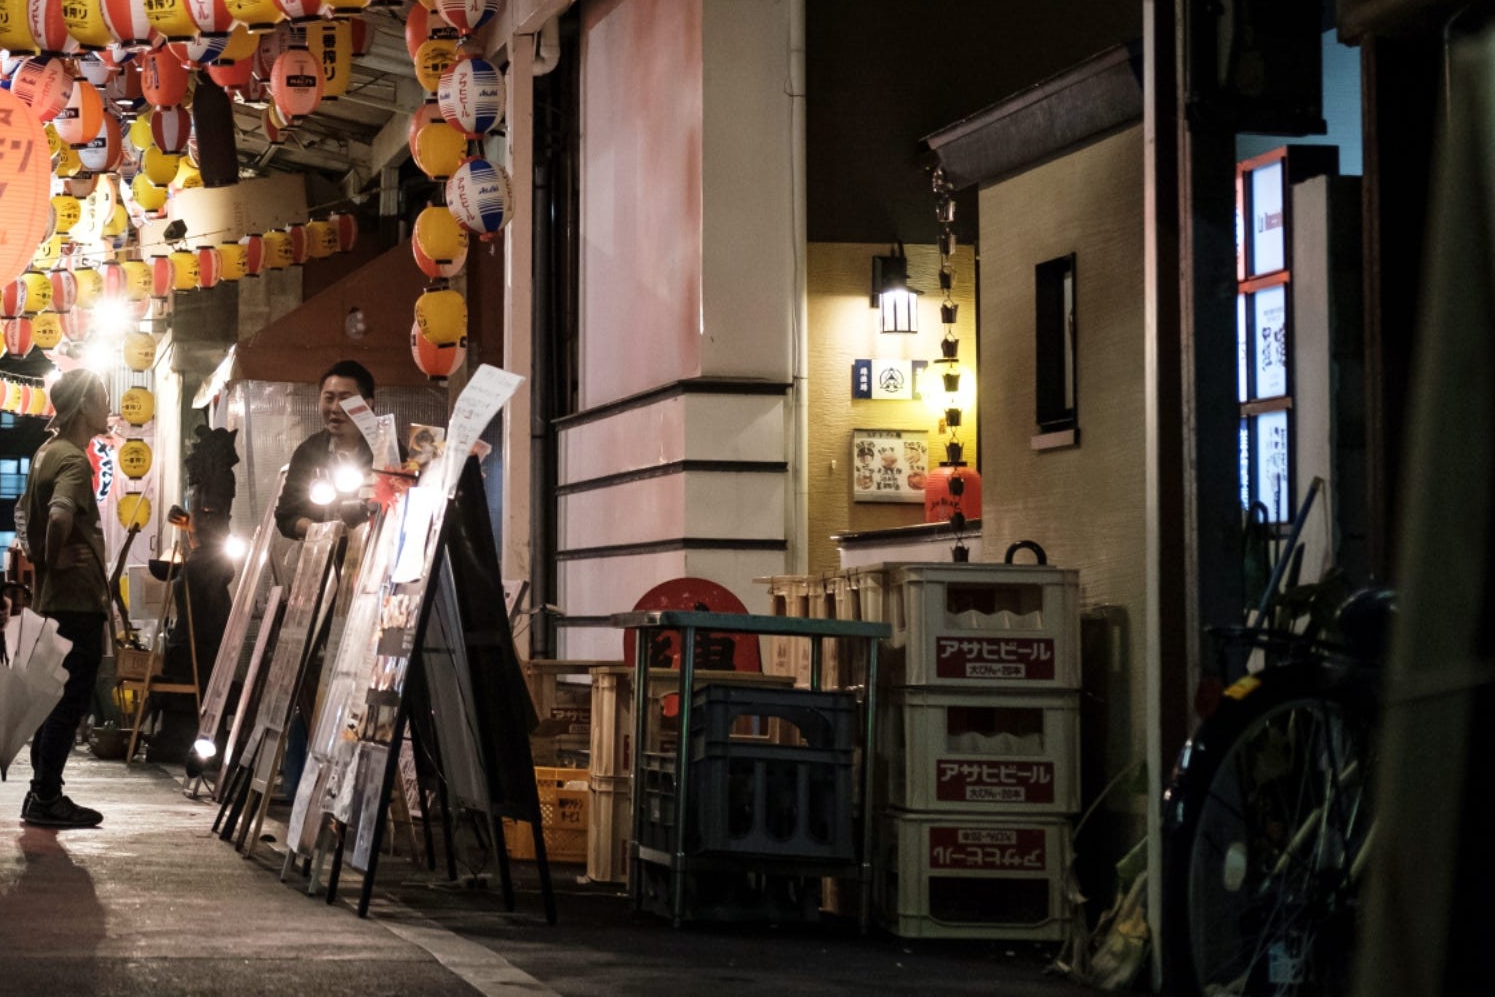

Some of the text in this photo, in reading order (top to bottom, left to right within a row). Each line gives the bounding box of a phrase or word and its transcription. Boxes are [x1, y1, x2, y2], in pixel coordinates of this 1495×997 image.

[458, 73, 470, 118] アサヒビール
[939, 640, 1052, 661] アサヒビール
[939, 763, 1052, 785] アサヒビール
[932, 845, 1044, 868] アサヒビール
